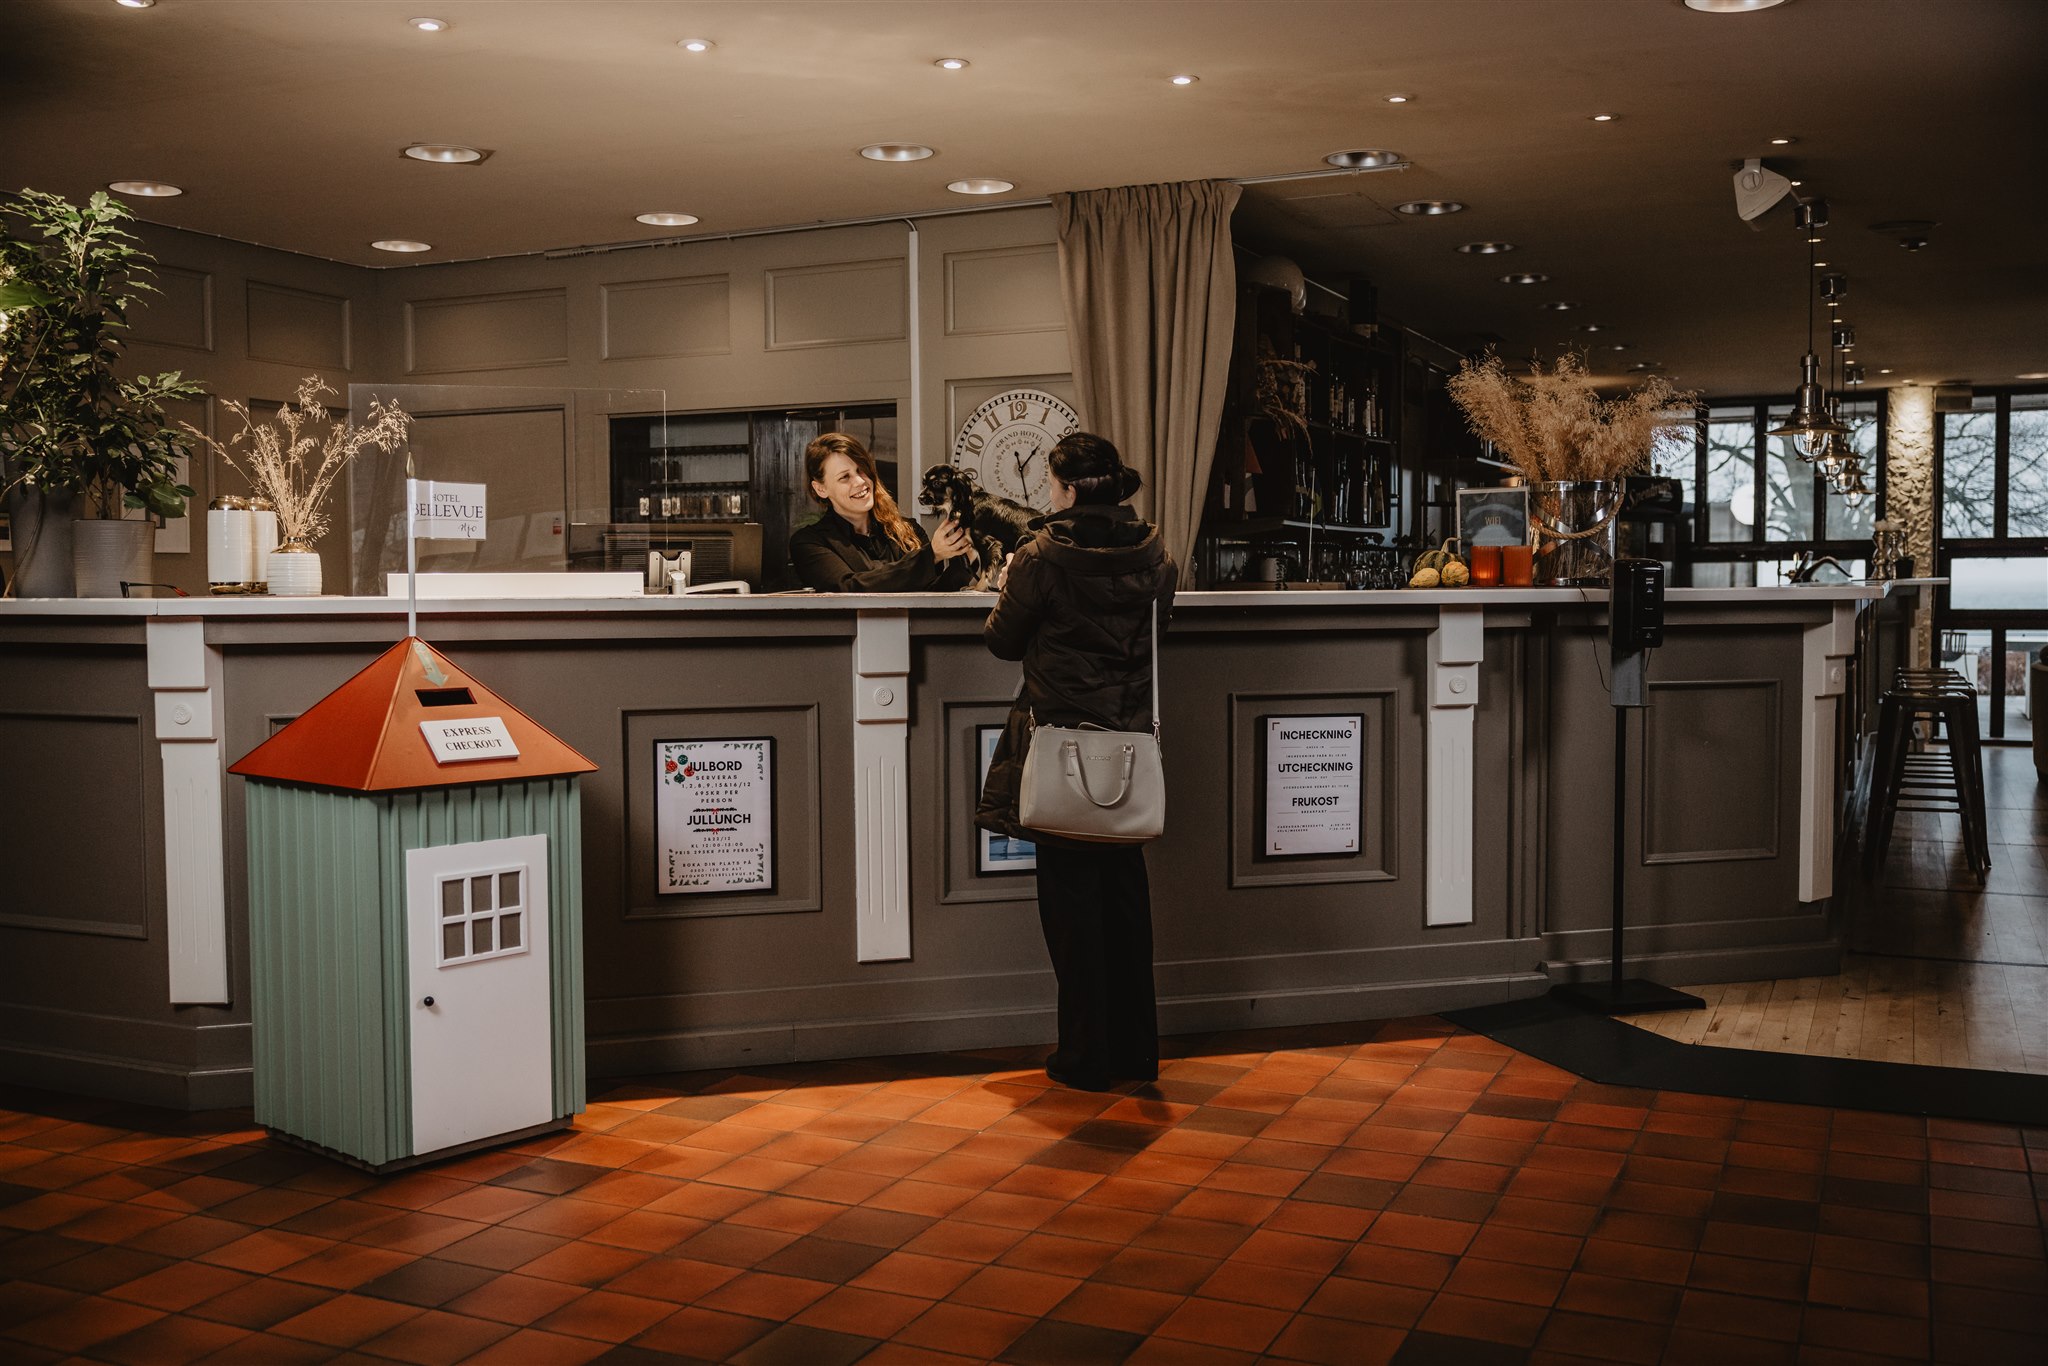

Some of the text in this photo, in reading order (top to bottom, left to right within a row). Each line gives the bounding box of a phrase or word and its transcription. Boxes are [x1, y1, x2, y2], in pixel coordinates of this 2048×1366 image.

[1008, 401, 1028, 421] 12
[1039, 407, 1051, 426] 1
[983, 410, 1003, 433] 11
[965, 434, 985, 457] 10
[995, 431, 1043, 448] GRAND HOTEL
[415, 503, 483, 518] BELLEVUE
[443, 726, 492, 737] EXPRESS
[1280, 729, 1352, 740] INCHECKNING
[445, 739, 503, 751] CHECKOUT
[688, 761, 742, 771] JULBORD
[1278, 762, 1353, 772] UTCHECKNING
[1292, 796, 1339, 806] FRUKOST
[687, 814, 751, 826] JULLUNCH
